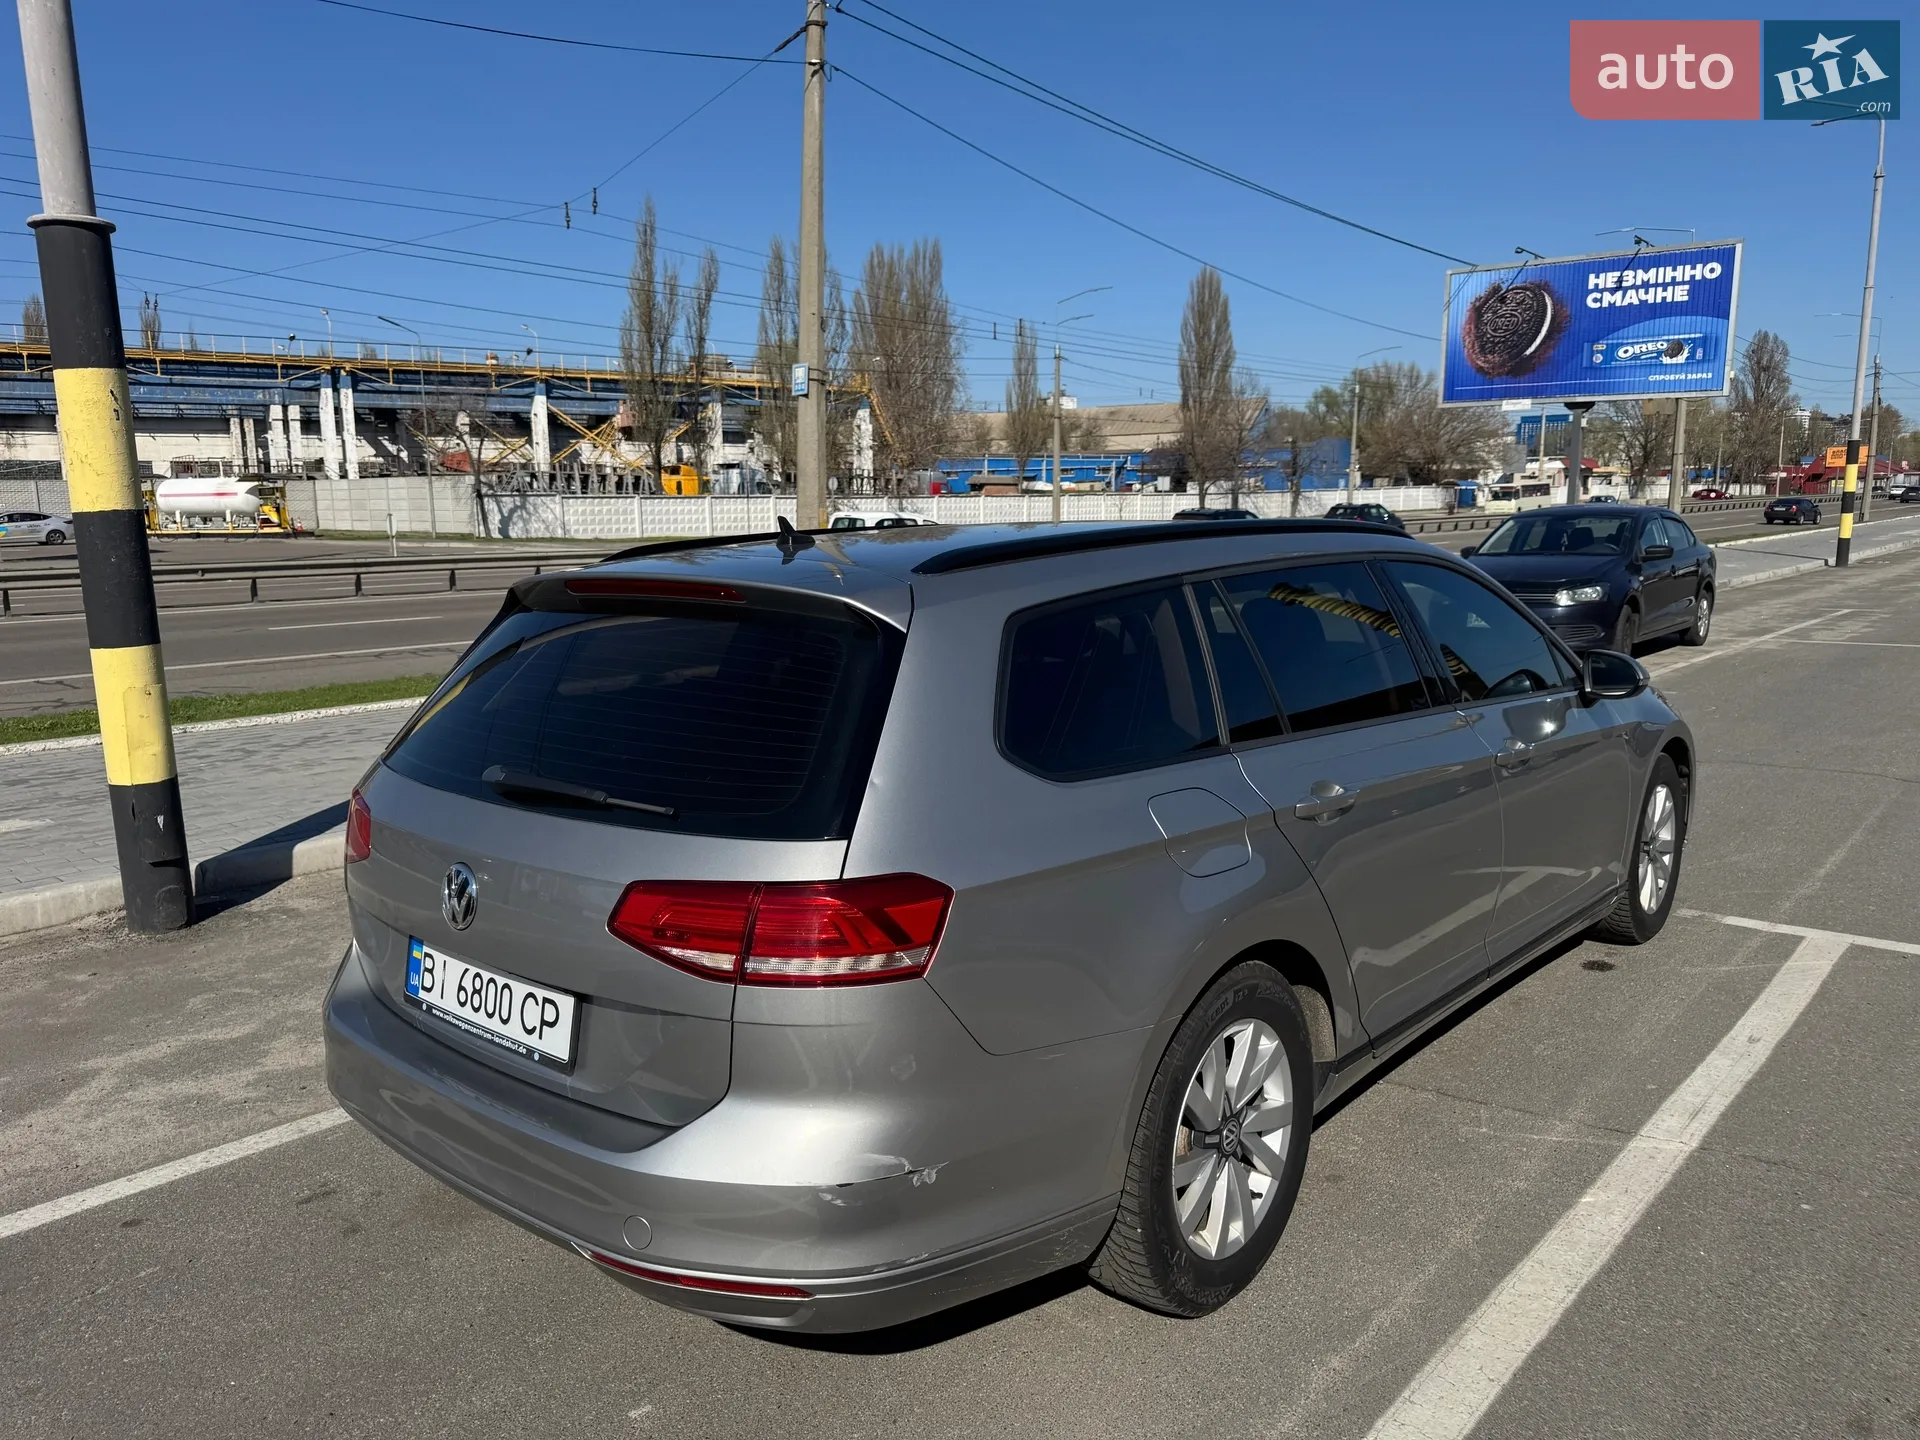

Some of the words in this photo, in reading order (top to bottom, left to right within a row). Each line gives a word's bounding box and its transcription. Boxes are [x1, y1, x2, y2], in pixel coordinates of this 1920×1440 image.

[1588, 262, 1722, 290] НЕЗМІННО
[1586, 284, 1690, 309] СМАЧНЕ
[1490, 317, 1519, 330] OREO
[1617, 341, 1668, 359] OREO
[1648, 372, 1686, 381] СПРОБУЙ
[1686, 372, 1713, 380] ЗАРАЗ
[410, 971, 420, 988] UA
[421, 951, 447, 1000] BI
[456, 967, 513, 1026] 6800
[520, 991, 560, 1041] CP
